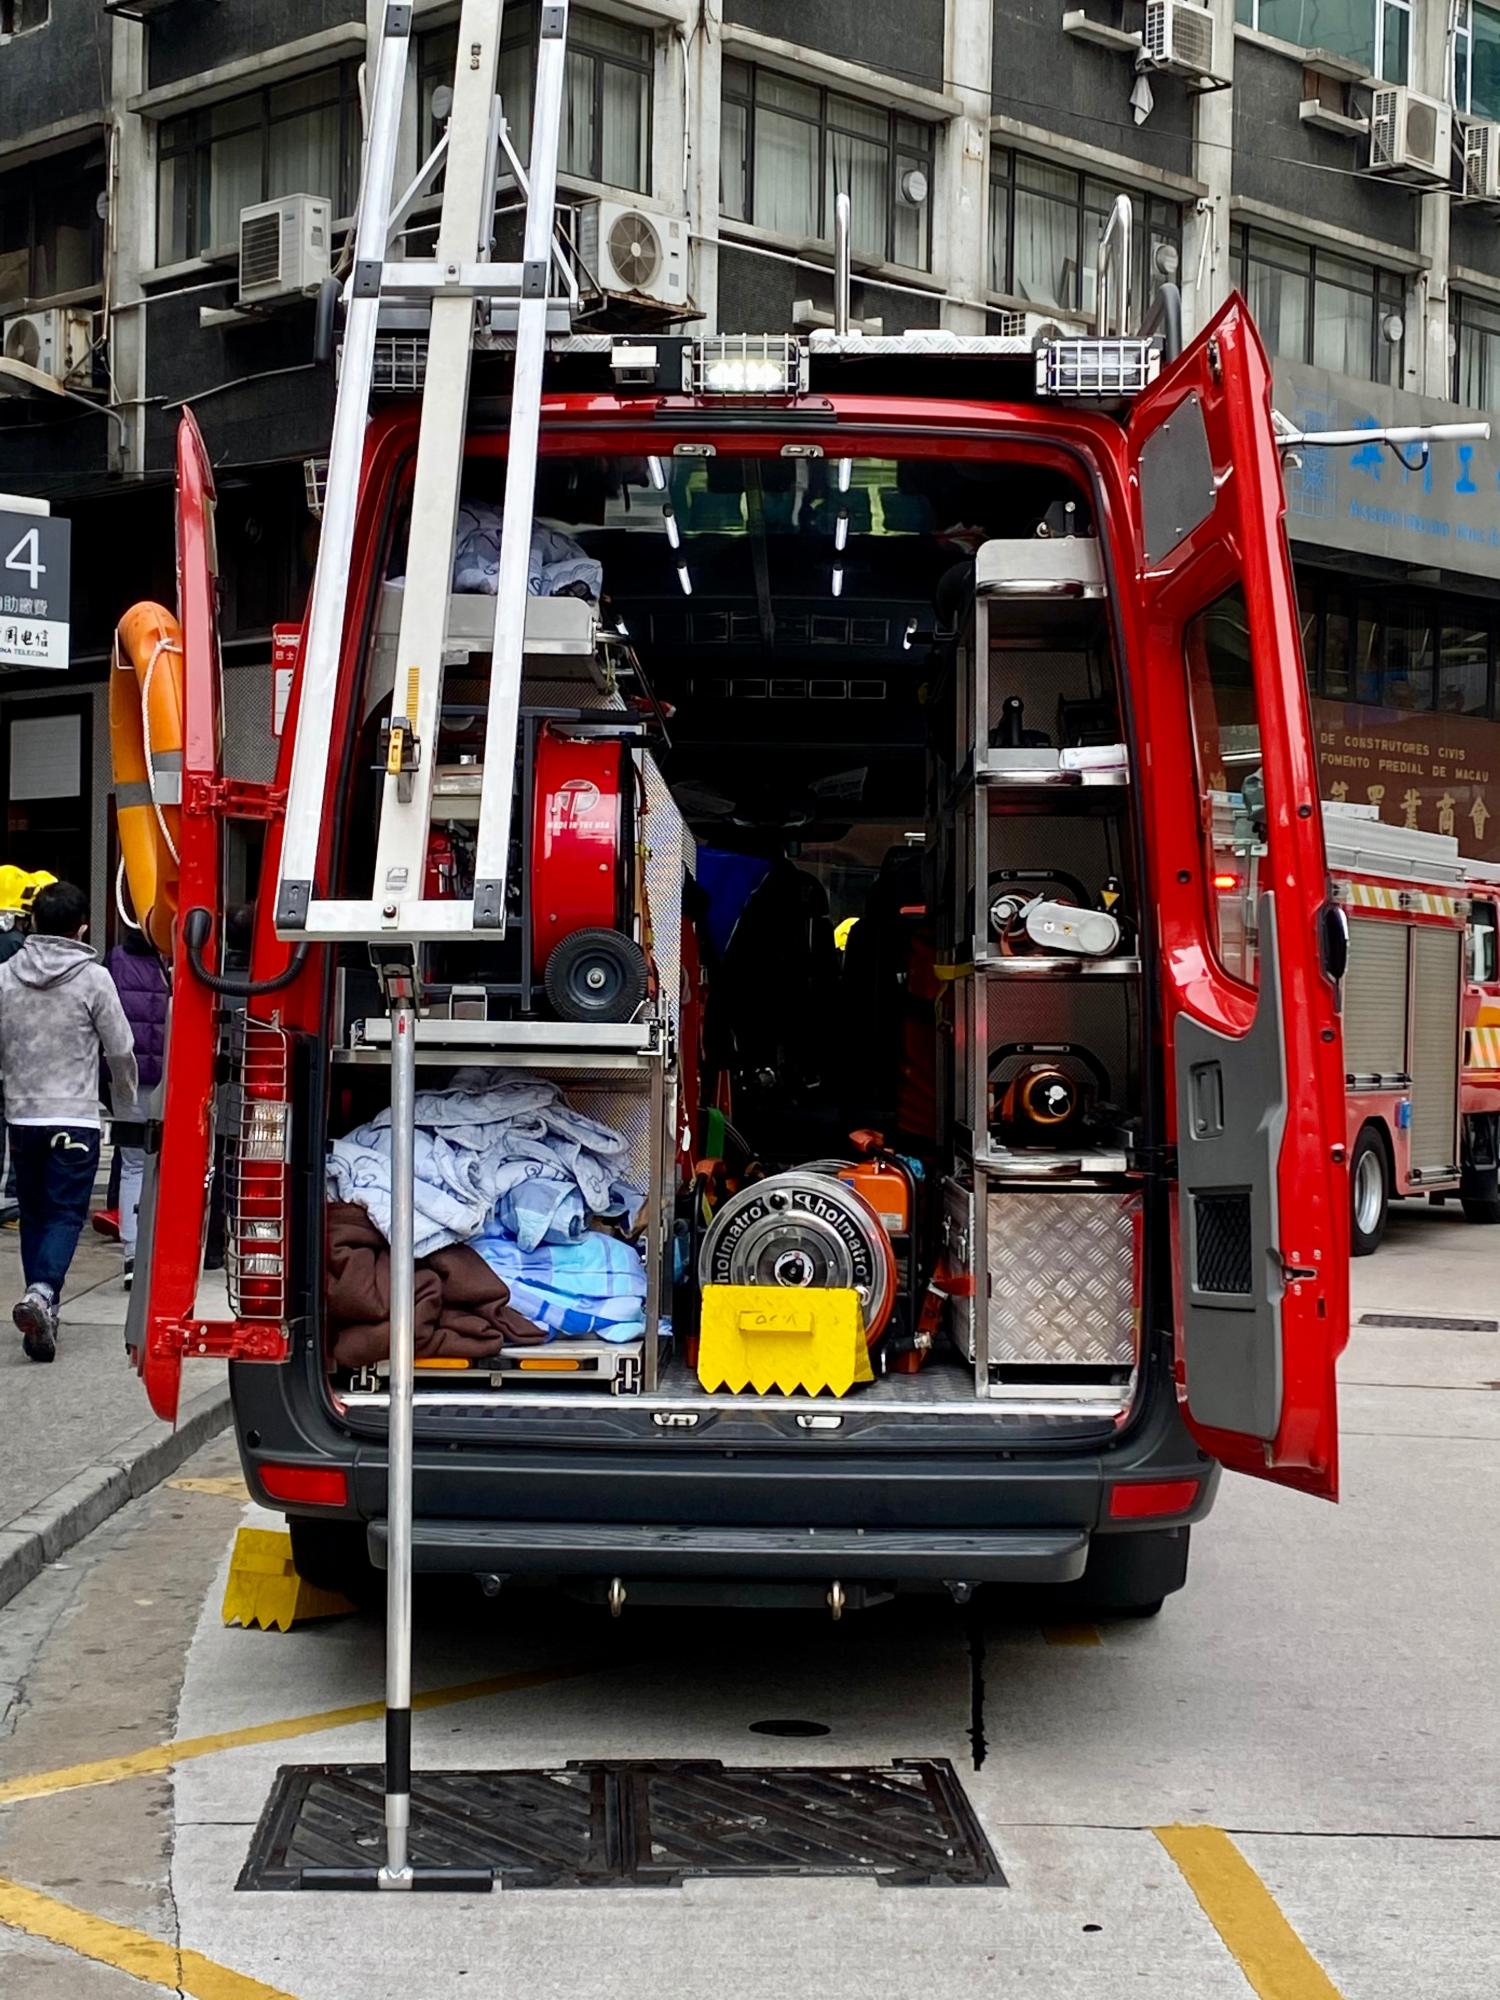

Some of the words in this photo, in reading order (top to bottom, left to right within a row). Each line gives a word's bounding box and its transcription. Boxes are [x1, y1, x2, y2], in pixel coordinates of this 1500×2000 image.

[0, 595, 48, 617] 助繳費
[0, 625, 49, 648] 国电信
[1320, 732, 1336, 746] DE
[1344, 736, 1431, 757] CONSTRUTORES
[1437, 747, 1467, 761] CIVIS
[1320, 752, 1371, 769] FOMENTO
[1378, 759, 1425, 776] PREDIAL
[1432, 765, 1448, 778] DE
[1455, 768, 1490, 784] MACAU
[714, 1205, 763, 1284] holmatro
[814, 1198, 868, 1277] holmatro
